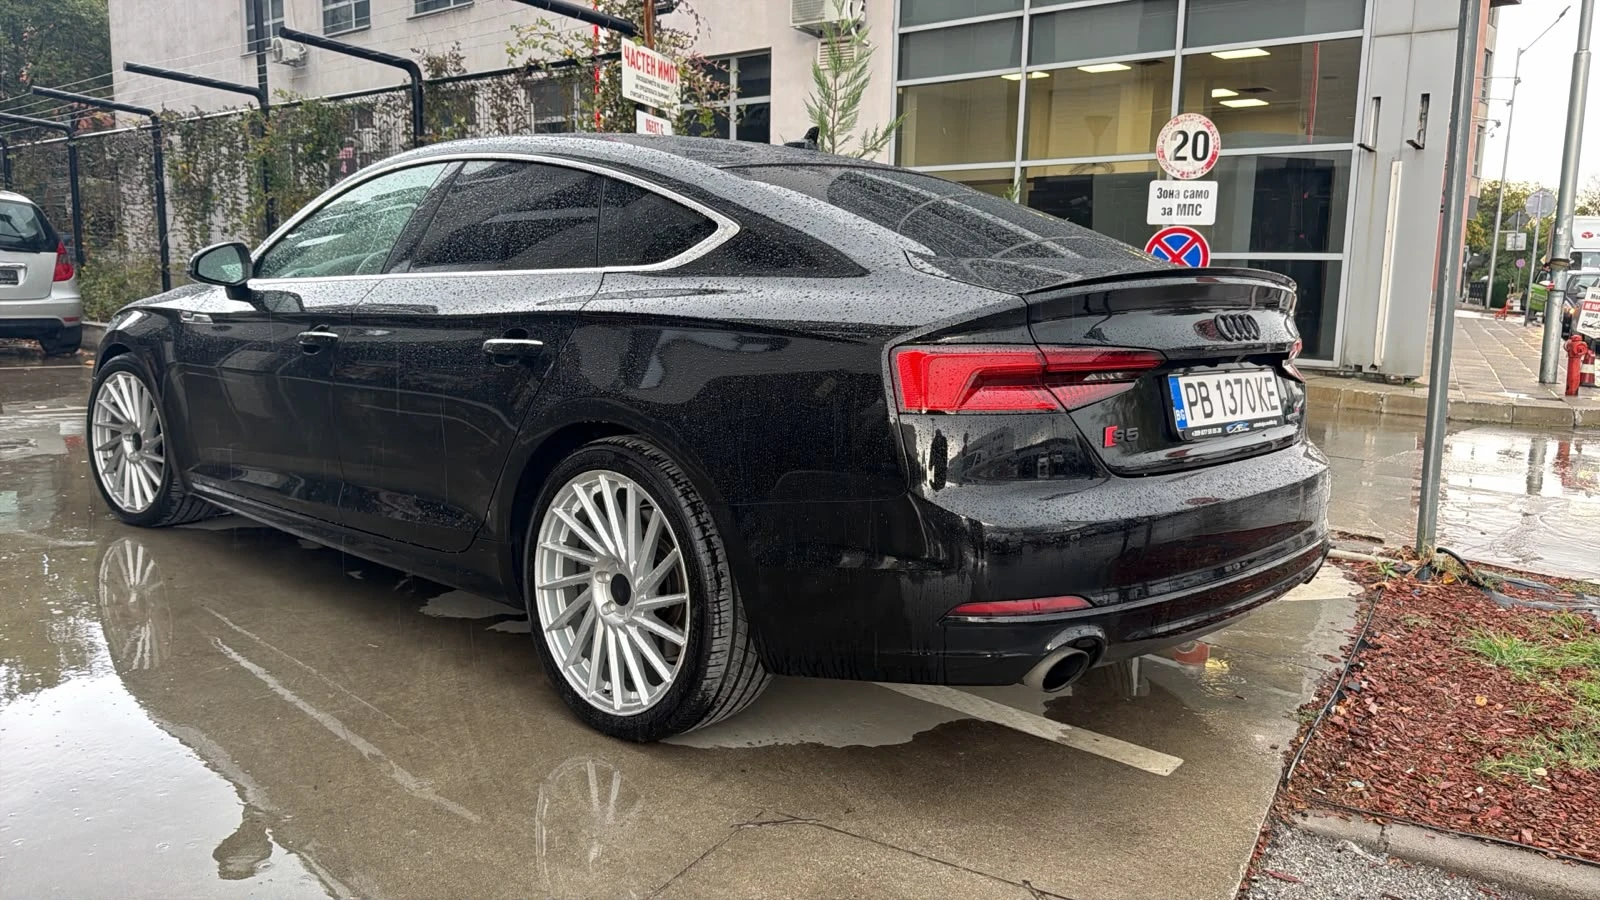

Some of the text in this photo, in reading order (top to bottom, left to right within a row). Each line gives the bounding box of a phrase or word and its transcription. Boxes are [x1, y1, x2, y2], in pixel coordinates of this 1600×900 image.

[624, 45, 656, 76] ЧАСТЕН
[657, 60, 678, 85] ИМОТ
[1169, 130, 1210, 162] 20
[1156, 187, 1209, 200] Зона само
[1161, 203, 1202, 217] за МПС
[1175, 409, 1186, 421] BG
